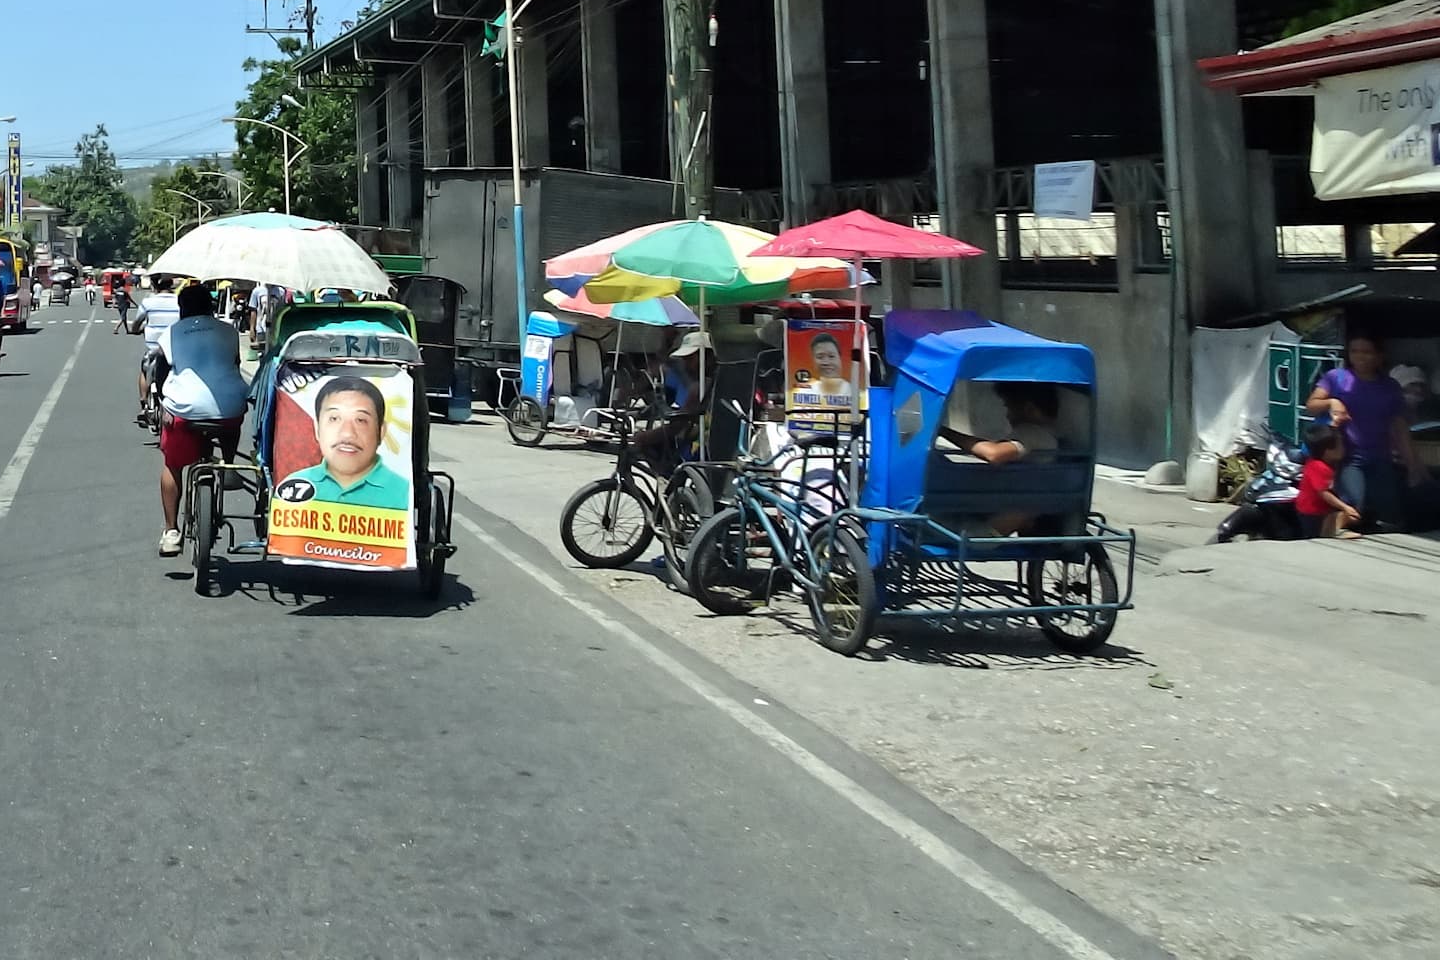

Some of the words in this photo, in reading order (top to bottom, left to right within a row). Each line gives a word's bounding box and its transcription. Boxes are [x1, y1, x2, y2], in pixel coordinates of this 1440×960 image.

[1357, 88, 1391, 113] The
[281, 482, 311, 500] #7
[273, 508, 319, 530] CESAR
[322, 512, 335, 532] S.
[339, 514, 405, 540] CASALME
[304, 542, 382, 561] Councilor
